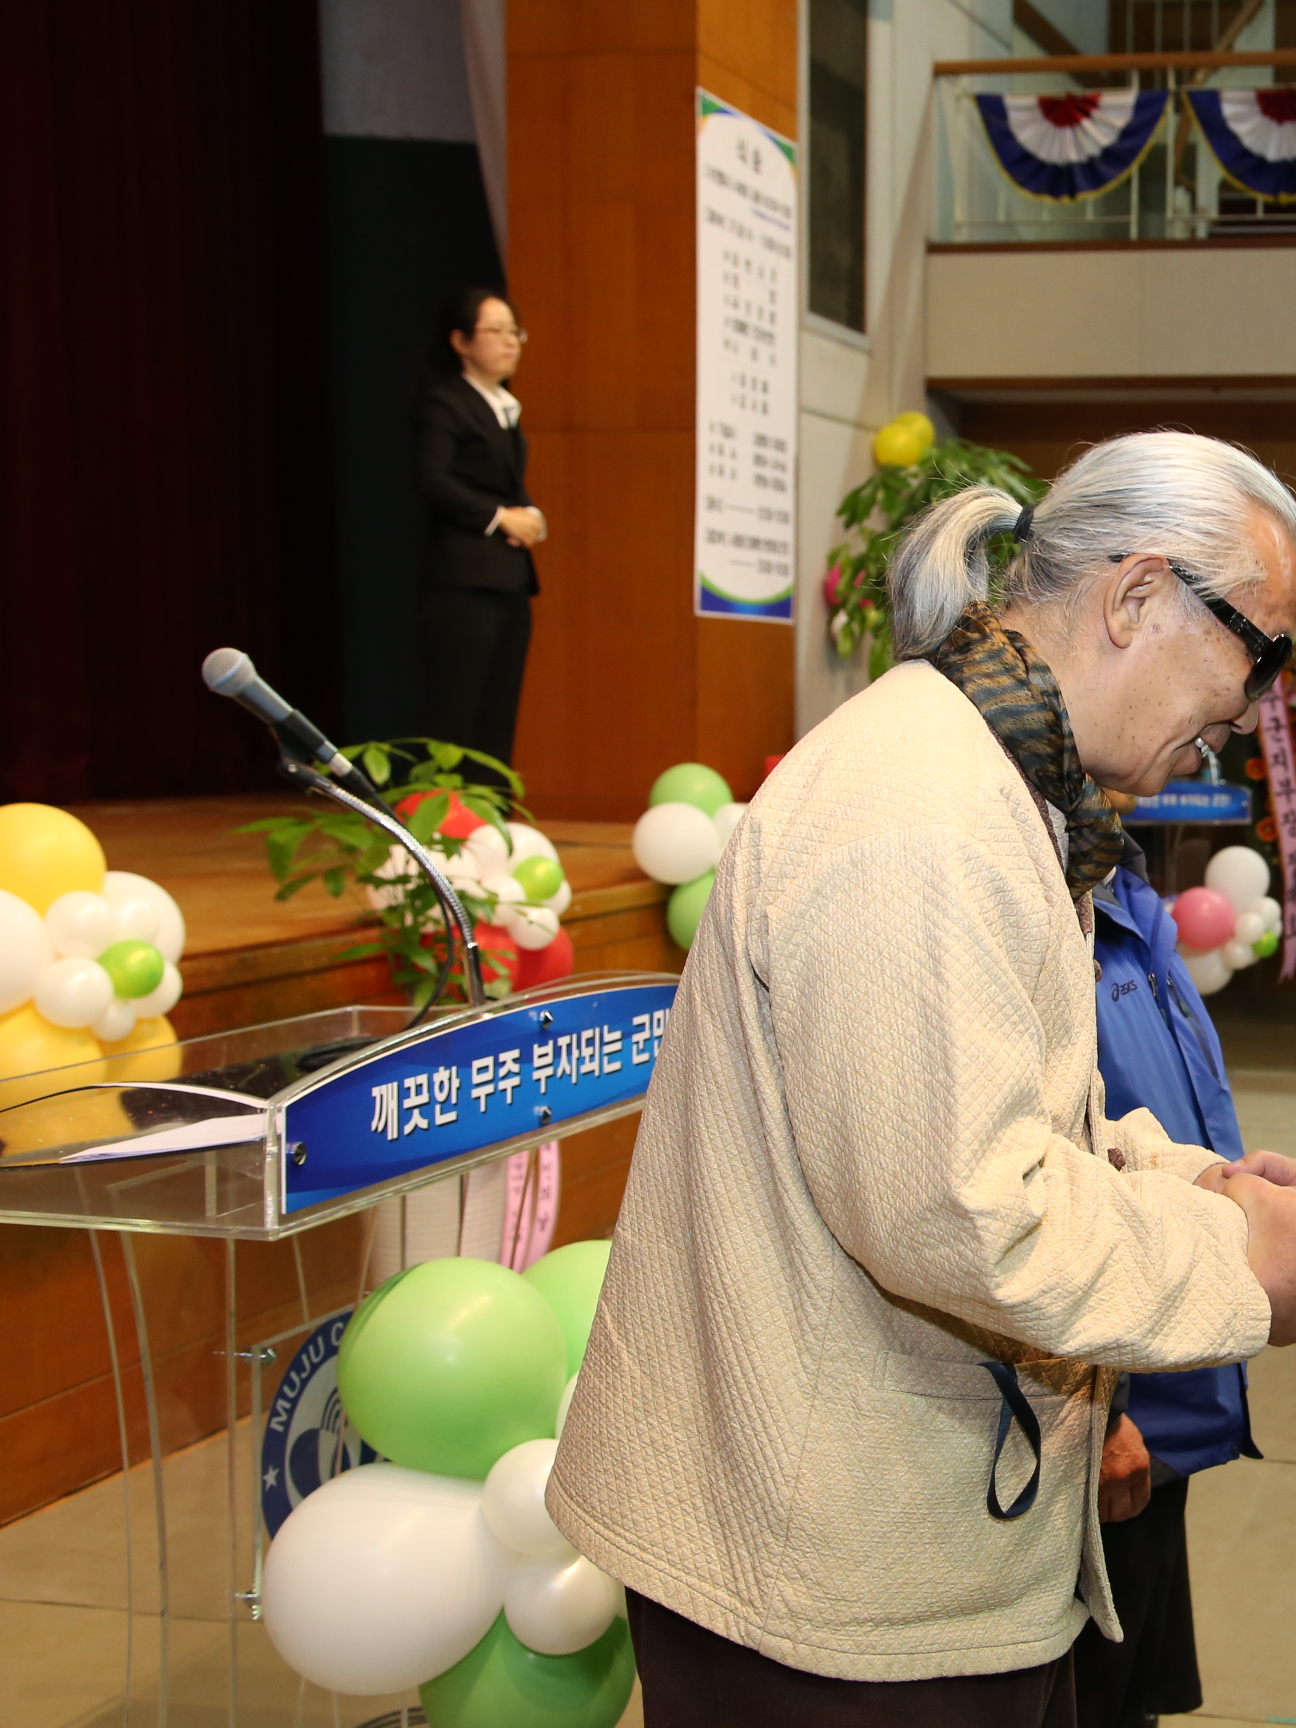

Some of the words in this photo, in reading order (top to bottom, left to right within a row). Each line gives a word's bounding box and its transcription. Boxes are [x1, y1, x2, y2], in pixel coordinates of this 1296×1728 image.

[370, 1066, 460, 1141] 깨끗한
[471, 1049, 521, 1112] 무주
[532, 1026, 622, 1094] 부자되는
[269, 1336, 326, 1433] MUJU
